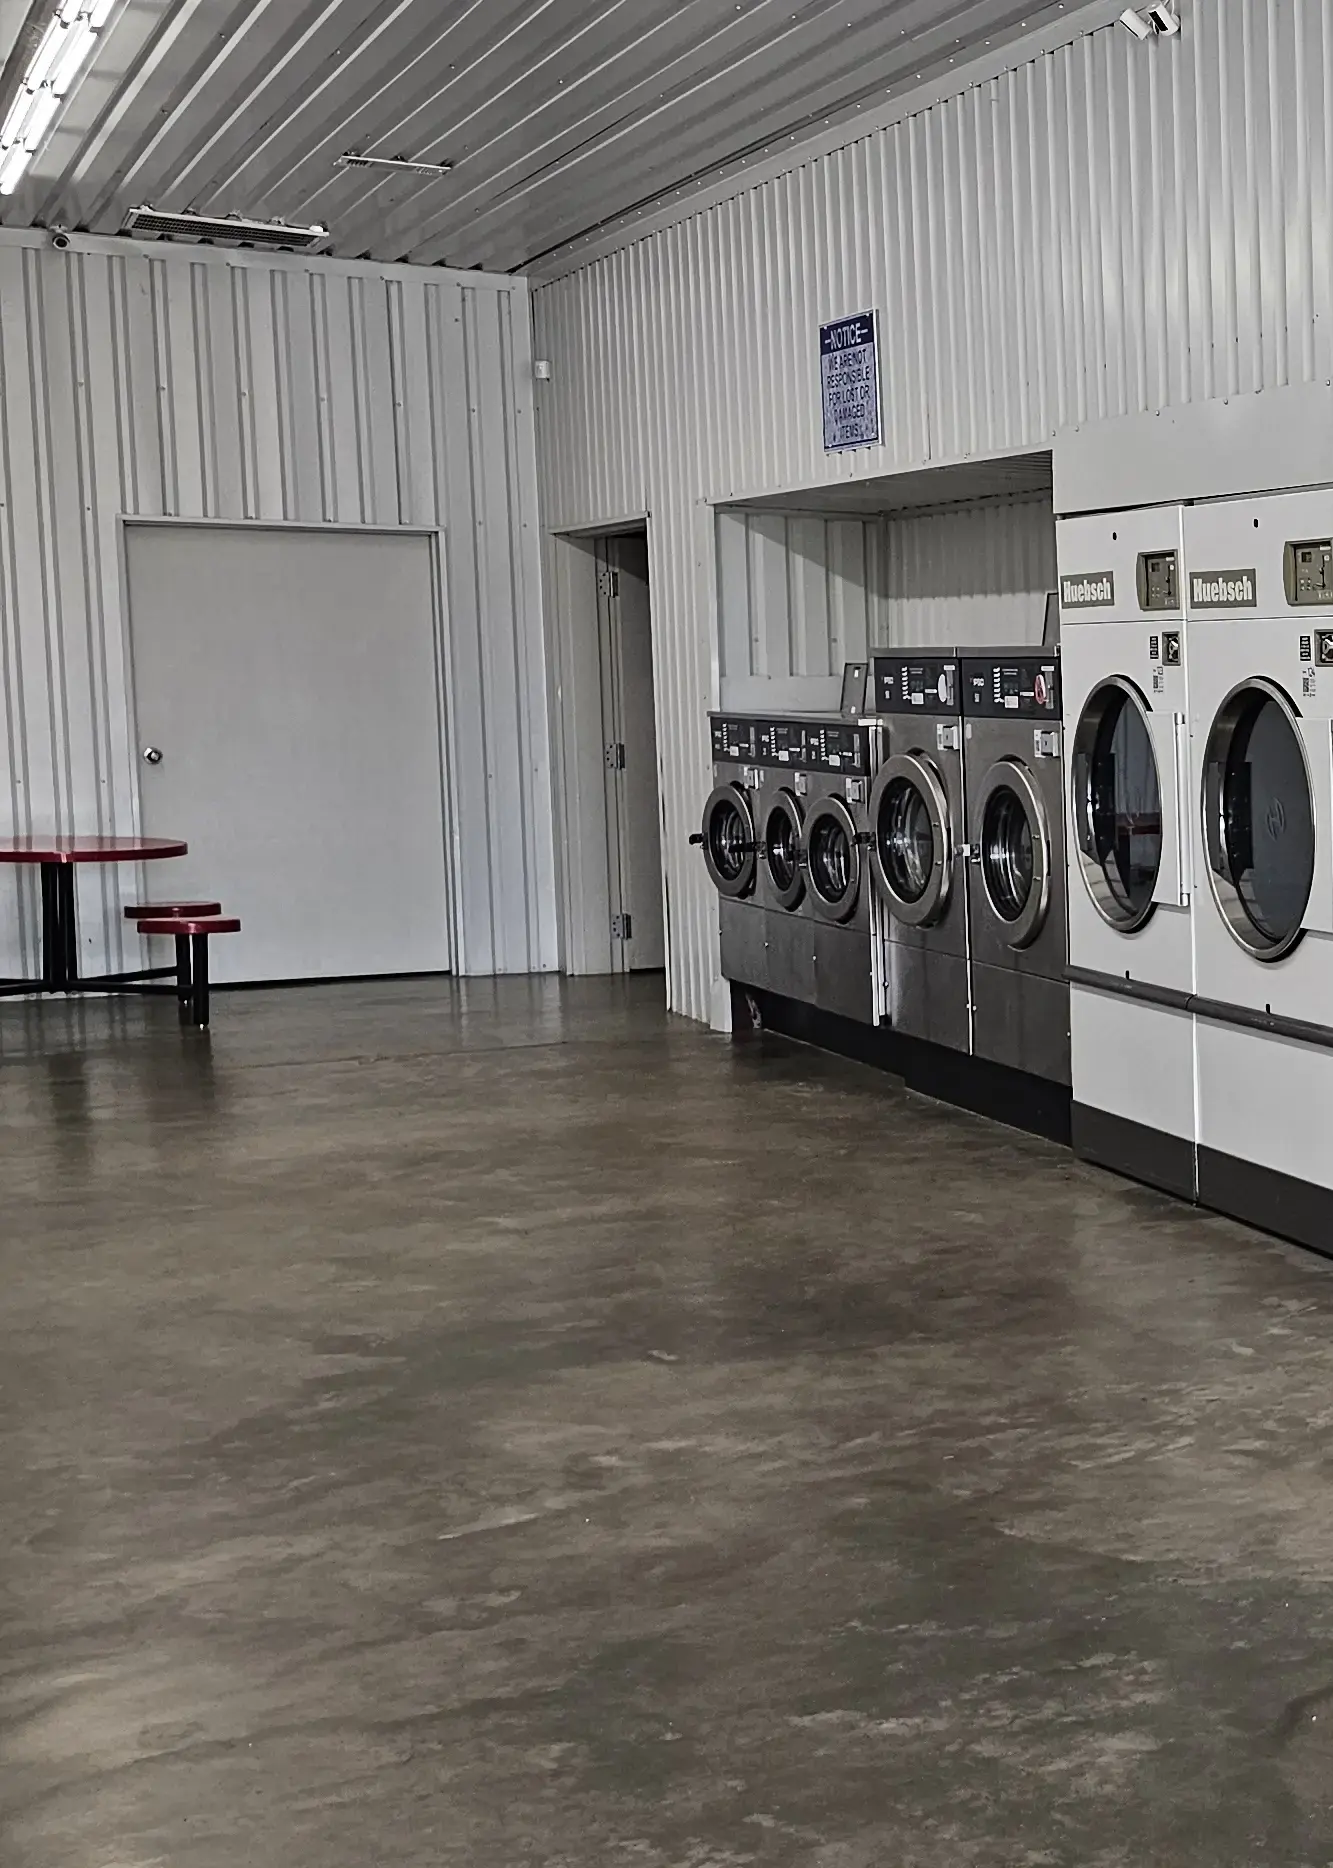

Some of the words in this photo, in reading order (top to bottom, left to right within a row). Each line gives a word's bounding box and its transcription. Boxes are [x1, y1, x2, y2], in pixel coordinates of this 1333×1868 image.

[830, 322, 862, 350] NOTICE
[828, 391, 841, 407] FOR
[842, 387, 859, 404] LOST
[860, 385, 870, 400] OR
[1063, 577, 1111, 602] Huebsch
[1193, 576, 1252, 602] Huebsch
